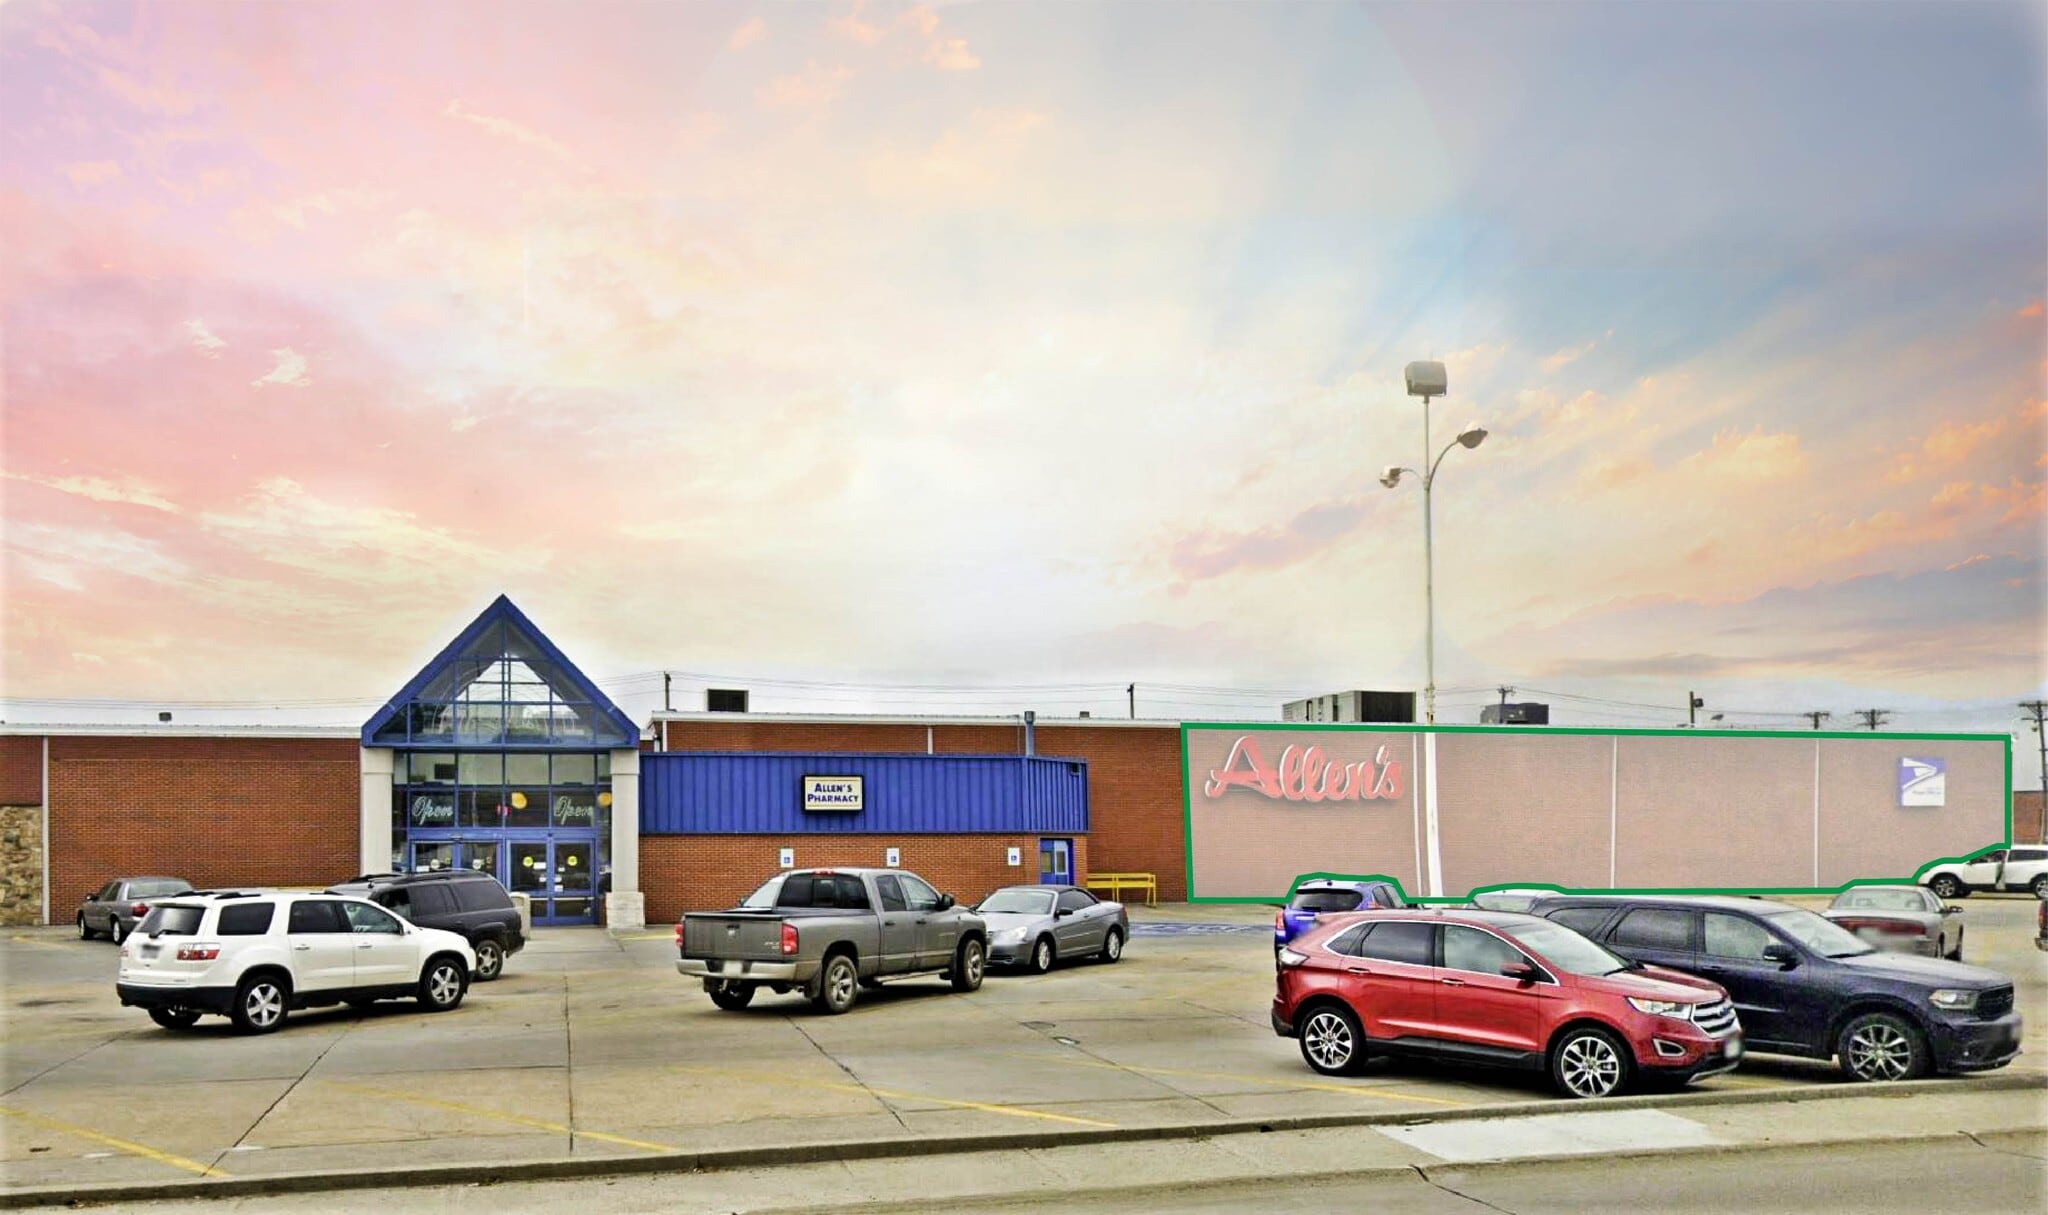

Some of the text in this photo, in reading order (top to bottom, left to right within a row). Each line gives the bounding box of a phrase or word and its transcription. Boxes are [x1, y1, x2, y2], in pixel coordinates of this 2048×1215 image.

[1205, 736, 1403, 802] Allen's
[807, 793, 859, 802] PHARMACY
[814, 782, 853, 793] ALLEN'S
[411, 796, 454, 825] Open
[554, 796, 594, 825] Open
